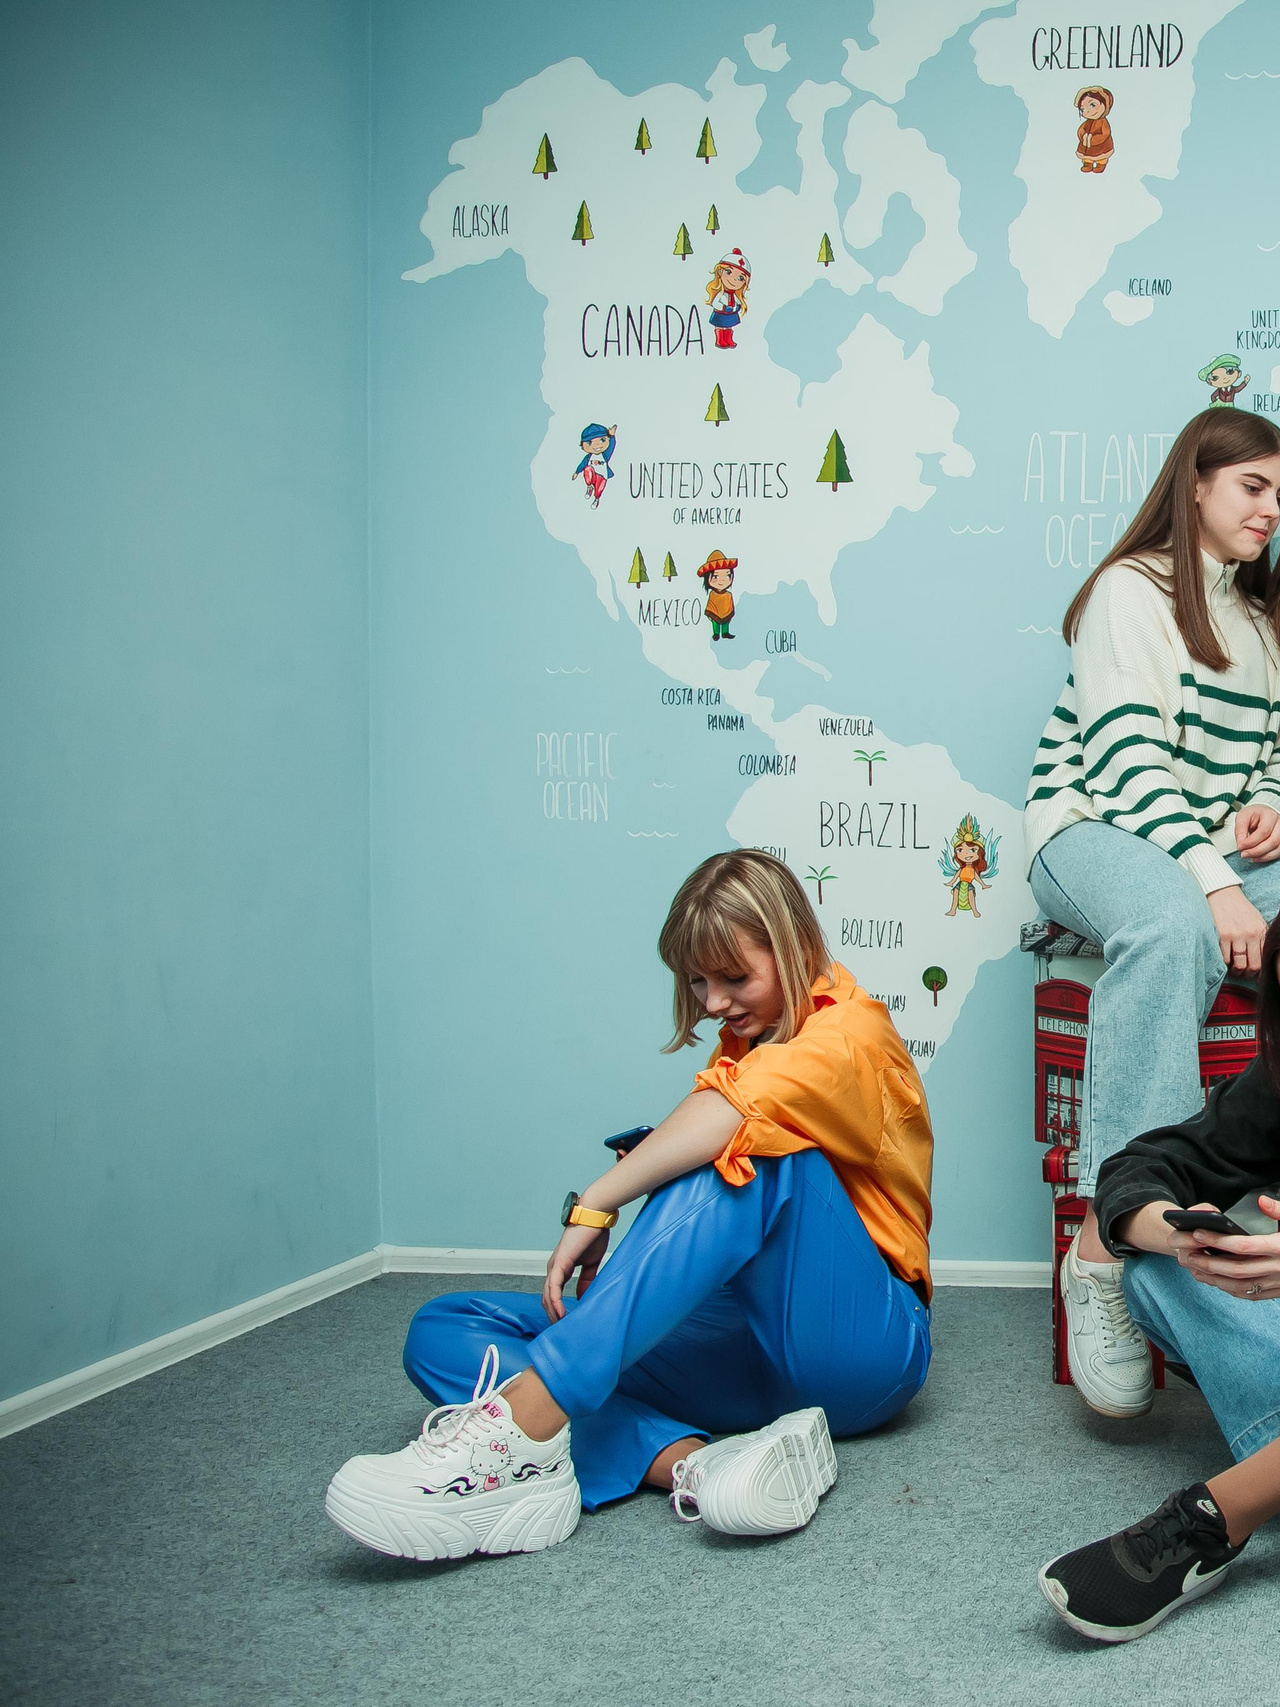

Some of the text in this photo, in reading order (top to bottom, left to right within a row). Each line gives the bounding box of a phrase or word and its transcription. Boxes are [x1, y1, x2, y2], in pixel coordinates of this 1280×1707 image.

[1032, 23, 1183, 71] GREENLAND
[453, 204, 508, 238] ALASKA
[1129, 278, 1171, 296] ICELAND
[582, 304, 704, 358] CANADA
[630, 462, 788, 498] UNITED STATES
[1024, 430, 1176, 504] ATLANT
[673, 507, 741, 525] OF AMERICA
[639, 598, 701, 627] MEXICO
[766, 630, 796, 654] CUBA
[662, 688, 720, 706] COSTA RICA
[708, 714, 744, 731] PANAMA
[819, 718, 873, 736] VENEZUELA
[537, 733, 617, 779] PACIFIC
[739, 754, 796, 776] COLOMBIA
[544, 781, 608, 822] OCEAN
[820, 801, 930, 849] BRAZIL
[842, 918, 902, 949] BOLIVIA
[1039, 1017, 1089, 1036] TELEPHON
